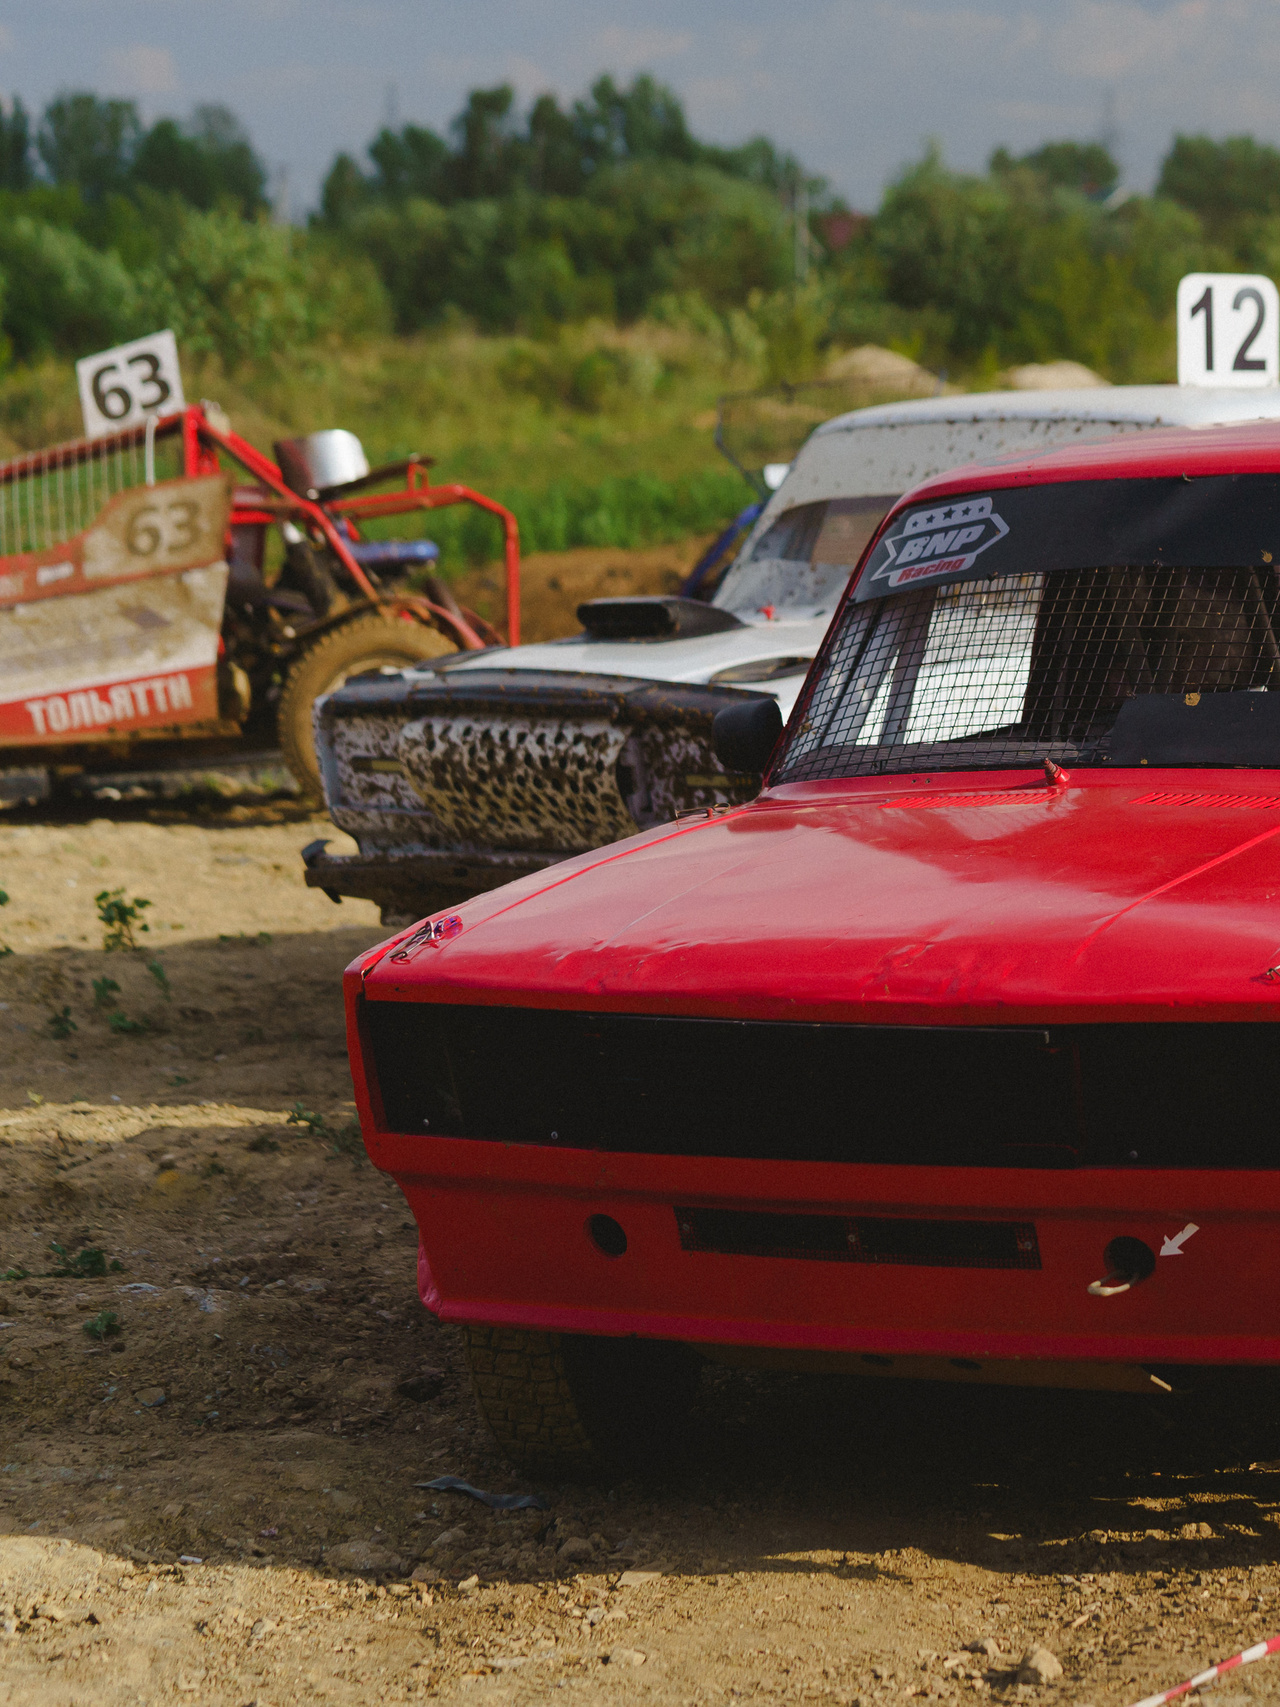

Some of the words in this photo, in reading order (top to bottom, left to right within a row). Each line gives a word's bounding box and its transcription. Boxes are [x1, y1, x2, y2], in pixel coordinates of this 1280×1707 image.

[1190, 287, 1267, 371] 12
[92, 353, 170, 420] 63
[126, 502, 199, 556] 63
[895, 524, 986, 566] BNP
[897, 557, 967, 583] Racing
[25, 673, 193, 735] ТОЛЬЯТТИ
